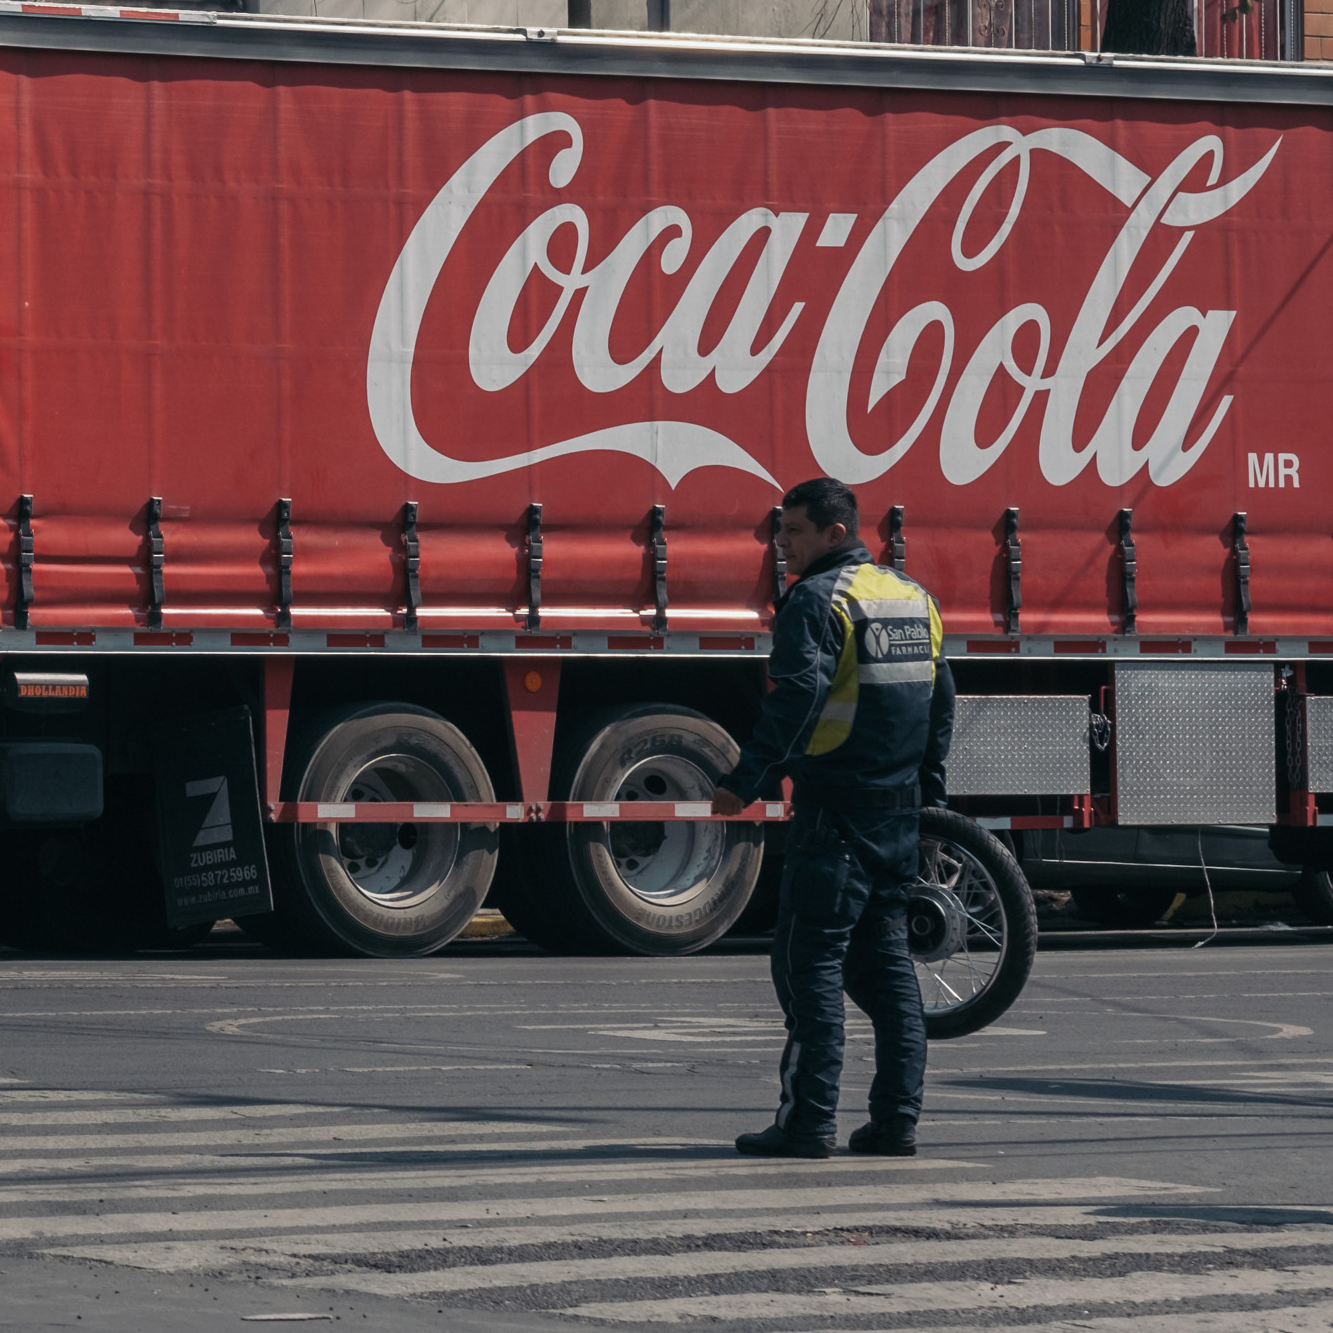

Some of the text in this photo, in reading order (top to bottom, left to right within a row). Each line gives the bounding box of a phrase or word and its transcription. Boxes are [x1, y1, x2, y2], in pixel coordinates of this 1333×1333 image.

[367, 111, 1283, 493] Coca-Cola
[1248, 452, 1300, 489] MR
[887, 624, 929, 641] San Pablo
[20, 684, 87, 697] DHOLLANDIA
[190, 847, 237, 867] ZUBIRIA
